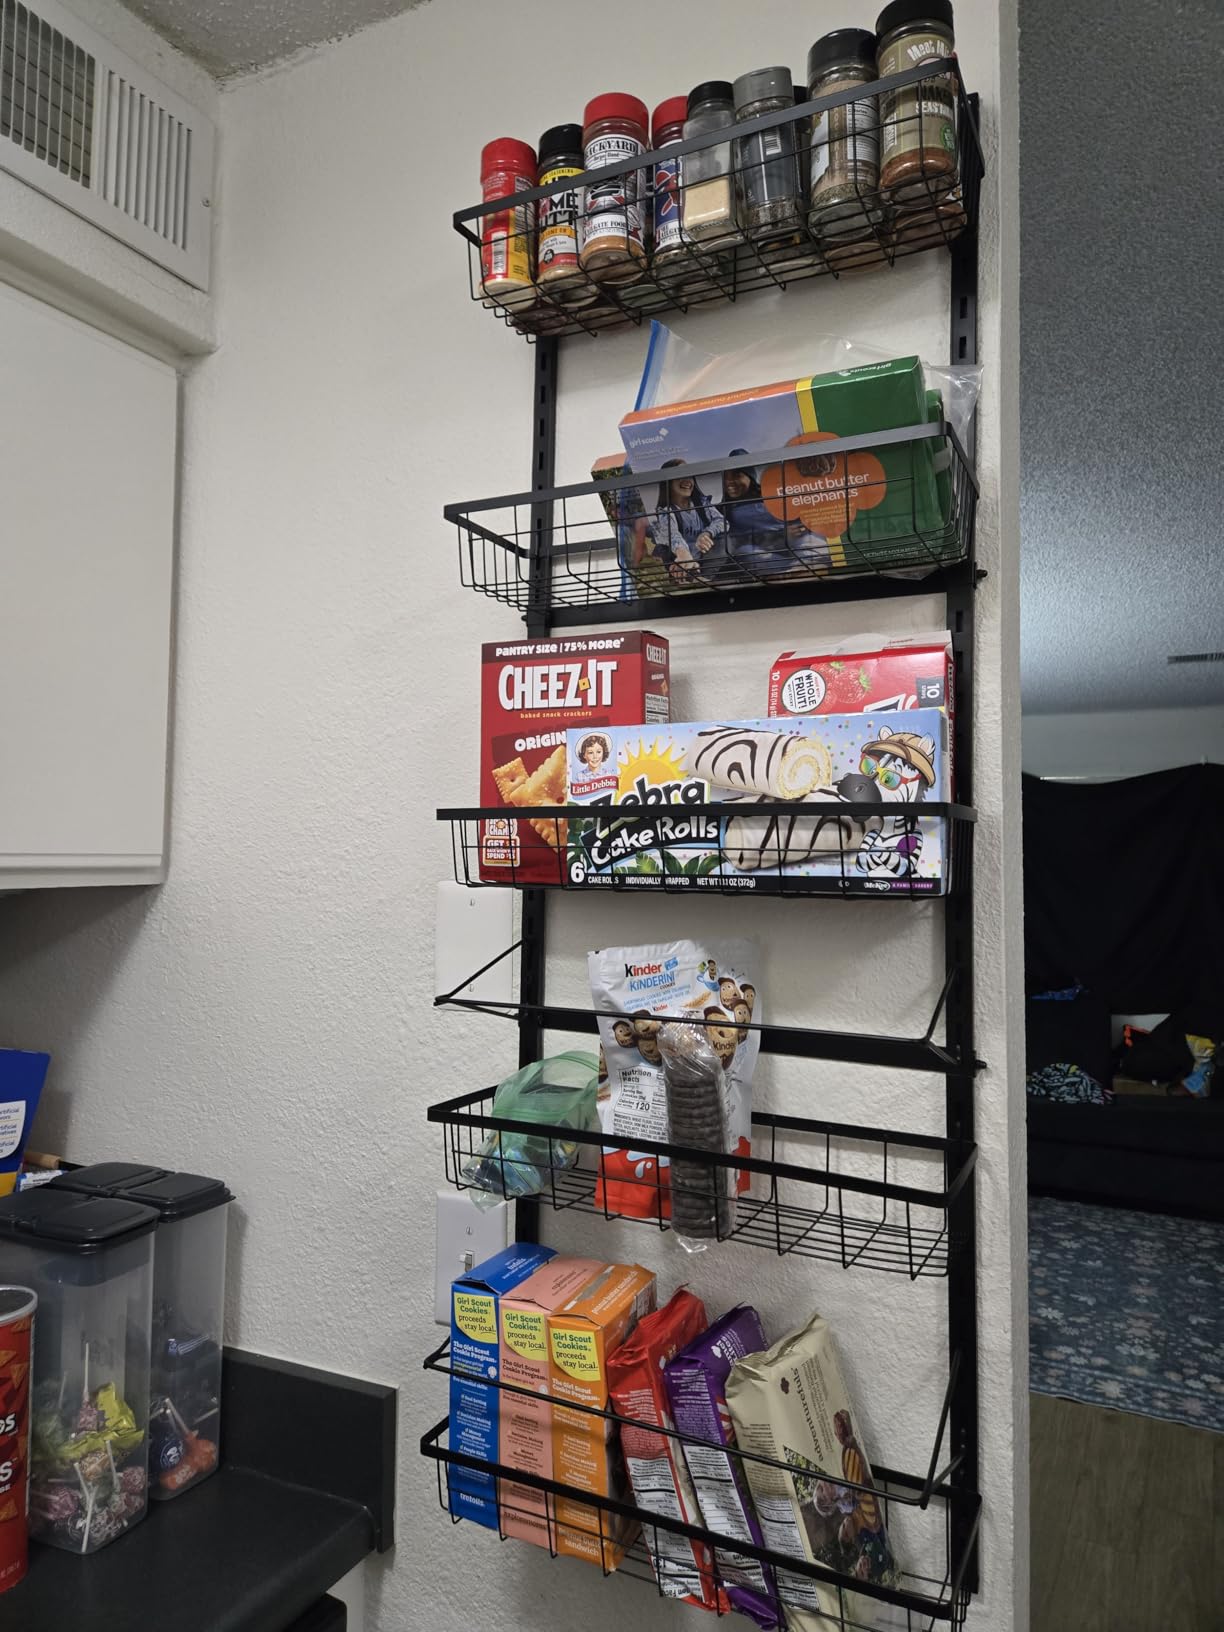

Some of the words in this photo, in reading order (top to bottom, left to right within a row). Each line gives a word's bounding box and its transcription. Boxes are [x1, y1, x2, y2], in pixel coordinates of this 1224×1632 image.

[907, 41, 935, 61] Meat
[585, 138, 637, 156] ACKYARD
[629, 438, 642, 449] girl
[642, 435, 664, 445] scouts
[776, 480, 824, 497] peanut
[563, 640, 587, 652] 75%
[772, 671, 780, 681] 10
[794, 676, 808, 709] FRUIT!
[805, 673, 817, 706] WHOLE
[926, 683, 940, 699] 10
[520, 711, 541, 719] baked
[572, 784, 590, 795] Little
[591, 780, 617, 792] Debbie
[591, 827, 655, 866] Cake
[657, 815, 719, 841] Rolls
[570, 861, 585, 884] 6
[588, 876, 602, 884] CAKE
[602, 876, 619, 884] ROLS
[625, 876, 661, 885] INDIVIDUALLY
[696, 877, 708, 886] NET
[708, 877, 719, 886] WT
[728, 878, 738, 887] OZ
[737, 877, 756, 888] (372g)
[624, 963, 662, 978] Kinder
[635, 1102, 650, 1111] 120
[457, 1297, 469, 1305] Girl
[471, 1299, 491, 1307] Scout
[458, 1315, 486, 1324] proceeds
[505, 1313, 518, 1321] Girl
[520, 1315, 541, 1324] Scout
[464, 1323, 477, 1332] stay
[507, 1331, 536, 1340] proceeds
[553, 1332, 567, 1341] Girl
[568, 1335, 591, 1343] Scout
[453, 1340, 463, 1348] The
[474, 1347, 490, 1356] Scout
[513, 1340, 527, 1349] stay
[453, 1347, 470, 1357] Cookie
[556, 1351, 586, 1361] proceeds
[502, 1358, 512, 1366] The
[513, 1361, 524, 1369] Girl
[525, 1364, 540, 1373] Scout
[502, 1364, 520, 1374] Cookie
[562, 1360, 577, 1370] stay
[552, 1377, 562, 1386] The
[563, 1381, 574, 1389] Girl
[575, 1385, 591, 1394] Scout
[552, 1384, 571, 1395] Cookie
[564, 1540, 599, 1557] sandwich
